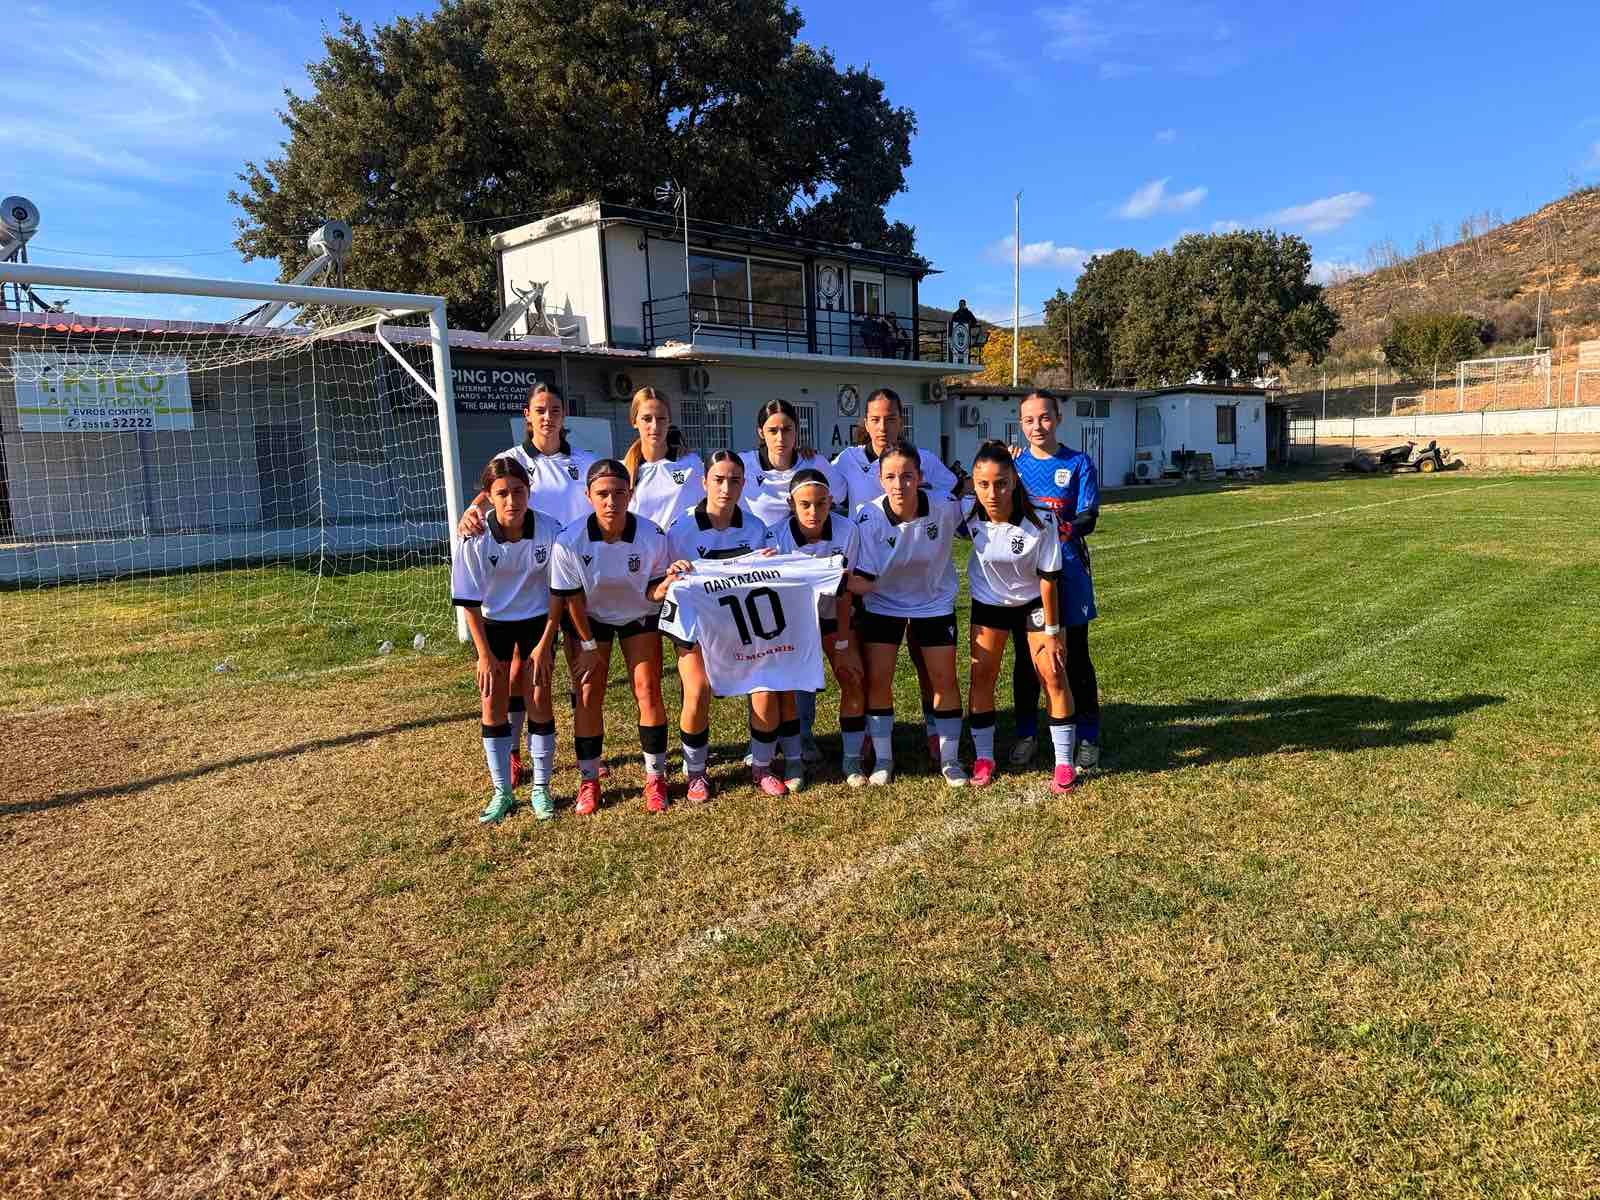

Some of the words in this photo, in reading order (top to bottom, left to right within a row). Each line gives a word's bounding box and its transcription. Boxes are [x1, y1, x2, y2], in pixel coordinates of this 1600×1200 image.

[450, 369, 487, 384] PING
[492, 371, 537, 385] PONG
[456, 384, 492, 393] INTERNET
[454, 392, 481, 400] IARDS
[479, 401, 497, 411] GAME
[499, 402, 505, 411] IS
[73, 408, 106, 416] EVROS
[108, 407, 150, 416] CONTROL
[112, 417, 153, 428] 32222
[718, 586, 786, 645] 10
